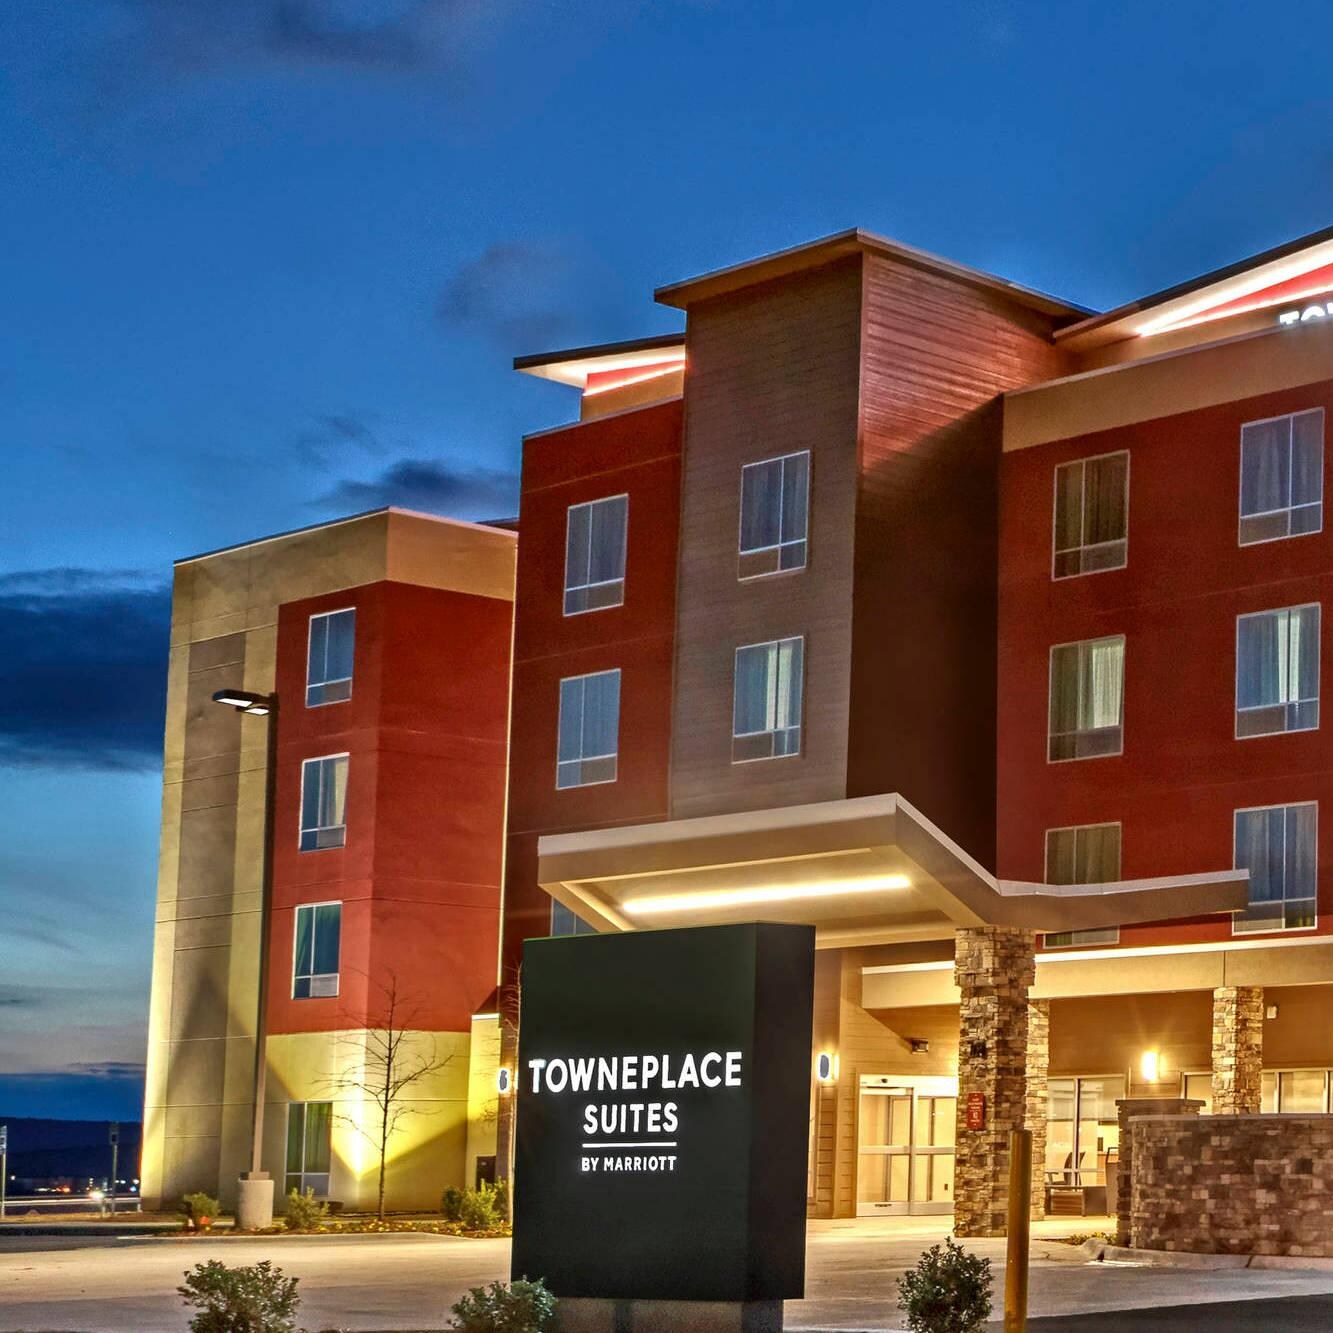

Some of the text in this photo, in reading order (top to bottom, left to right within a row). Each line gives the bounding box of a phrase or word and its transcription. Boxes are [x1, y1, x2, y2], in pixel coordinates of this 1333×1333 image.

[528, 1051, 742, 1093] TOWNEPLACE
[583, 1102, 678, 1134] SUITES
[581, 1155, 677, 1172] BY MARRIOTT
